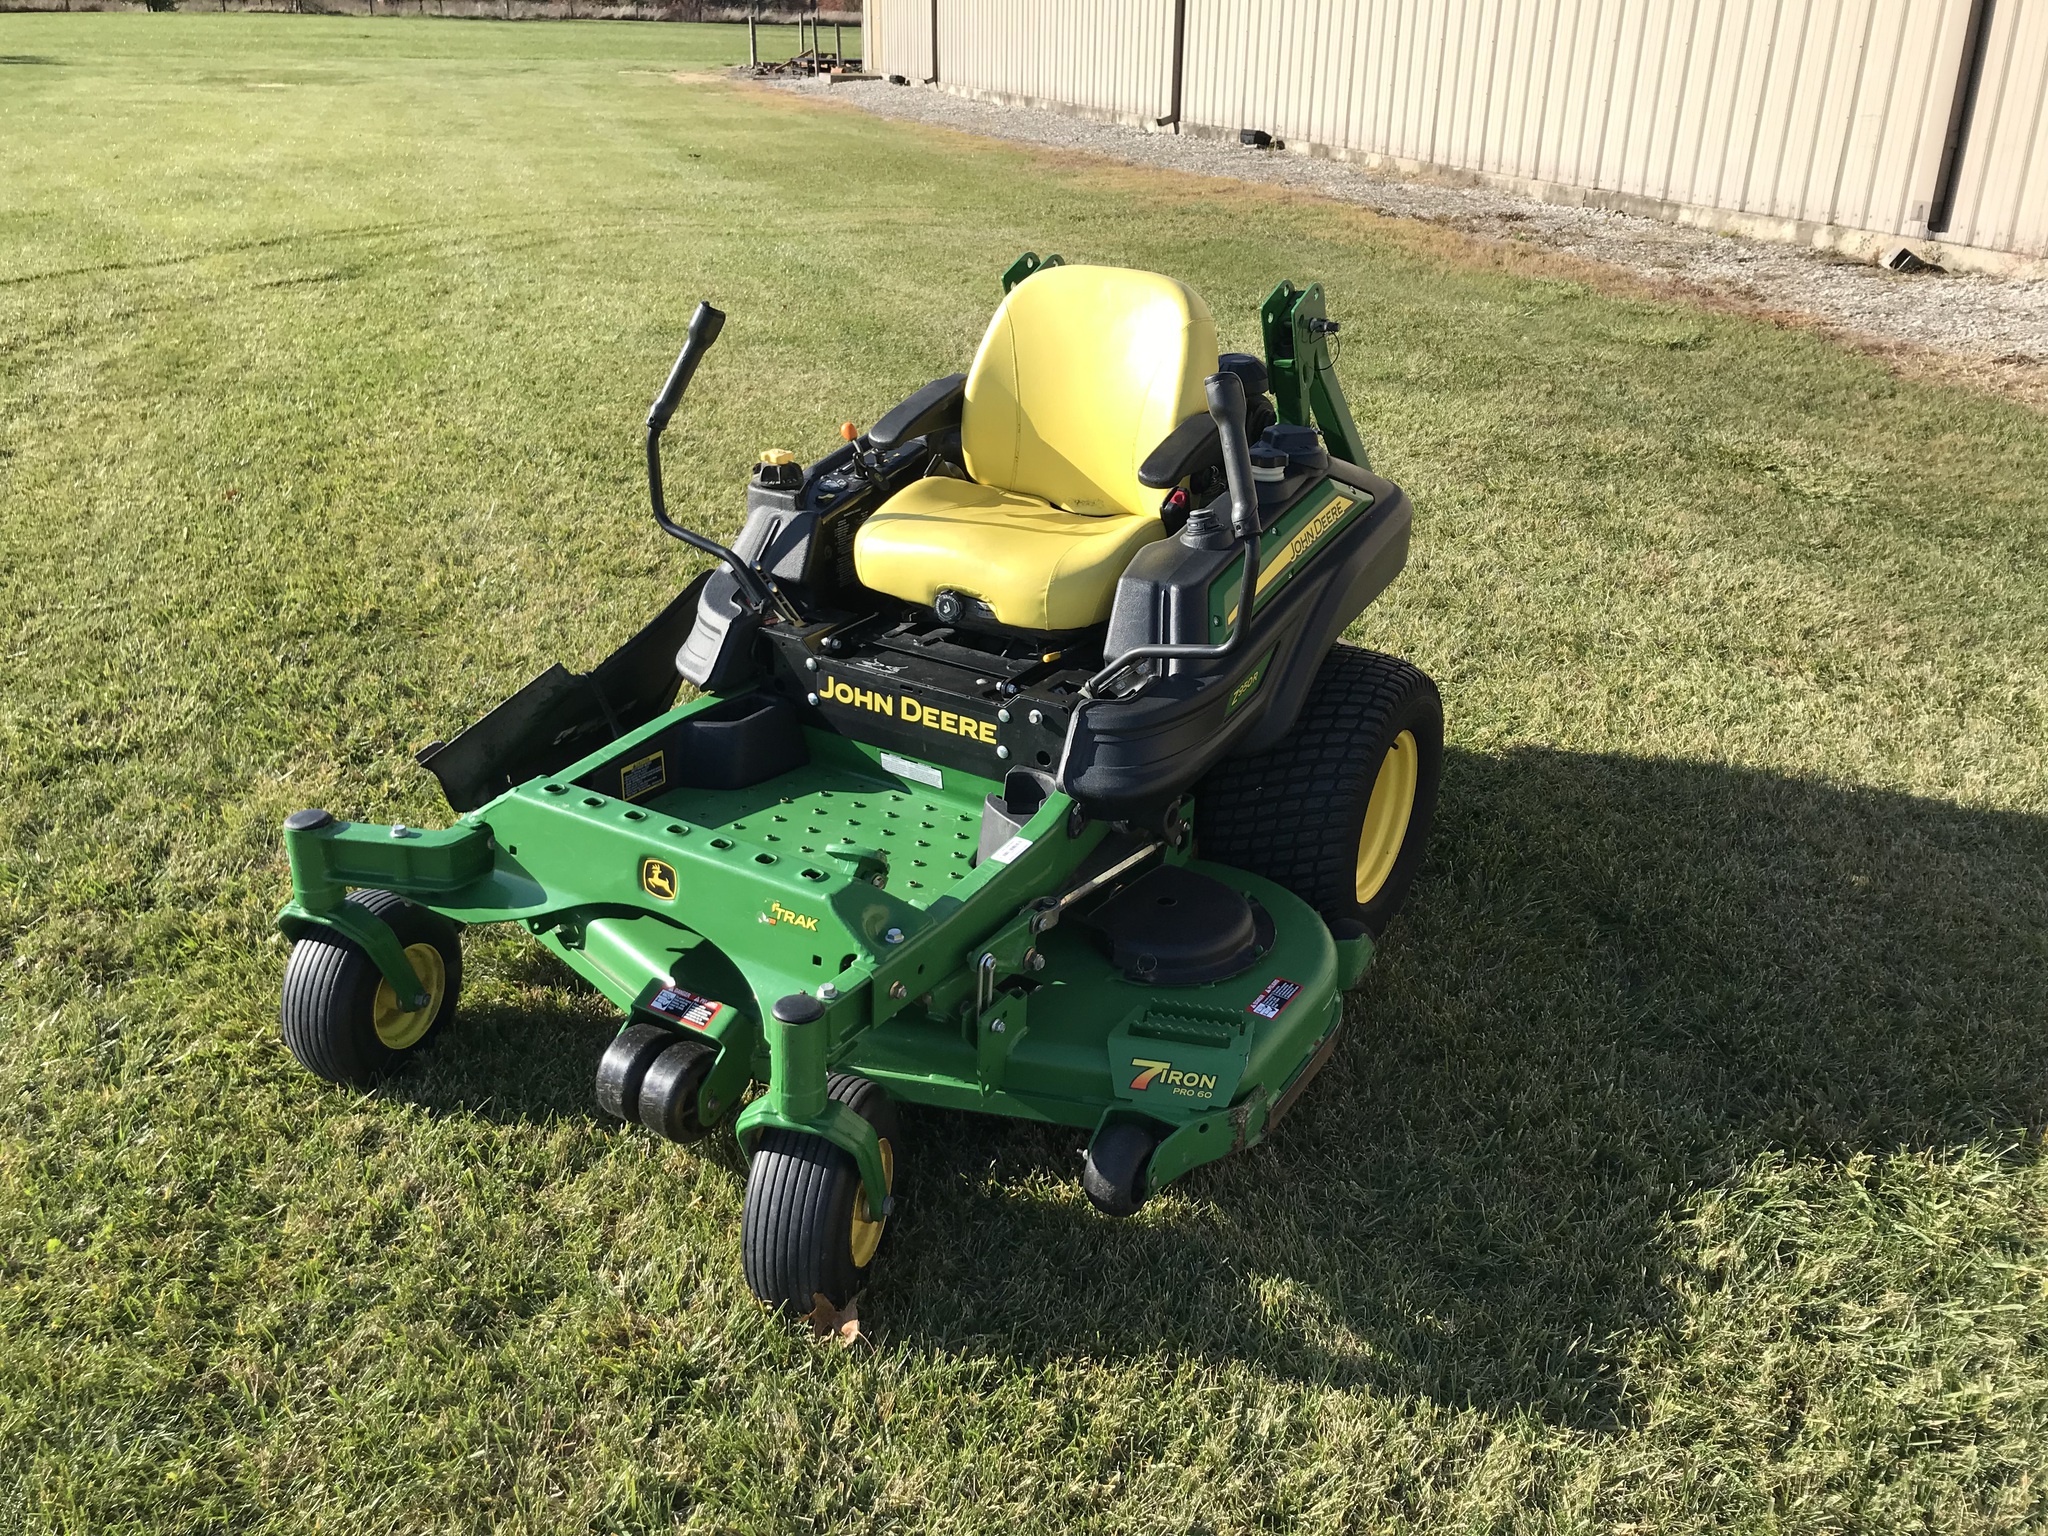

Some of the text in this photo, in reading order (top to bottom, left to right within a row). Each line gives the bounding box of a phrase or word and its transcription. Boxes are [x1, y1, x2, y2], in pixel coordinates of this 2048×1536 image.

[1290, 501, 1344, 561] JOHN DEERE
[819, 675, 998, 745] JOHN DEERE
[768, 902, 819, 932] TRAK
[1172, 1087, 1213, 1099] PRO 60
